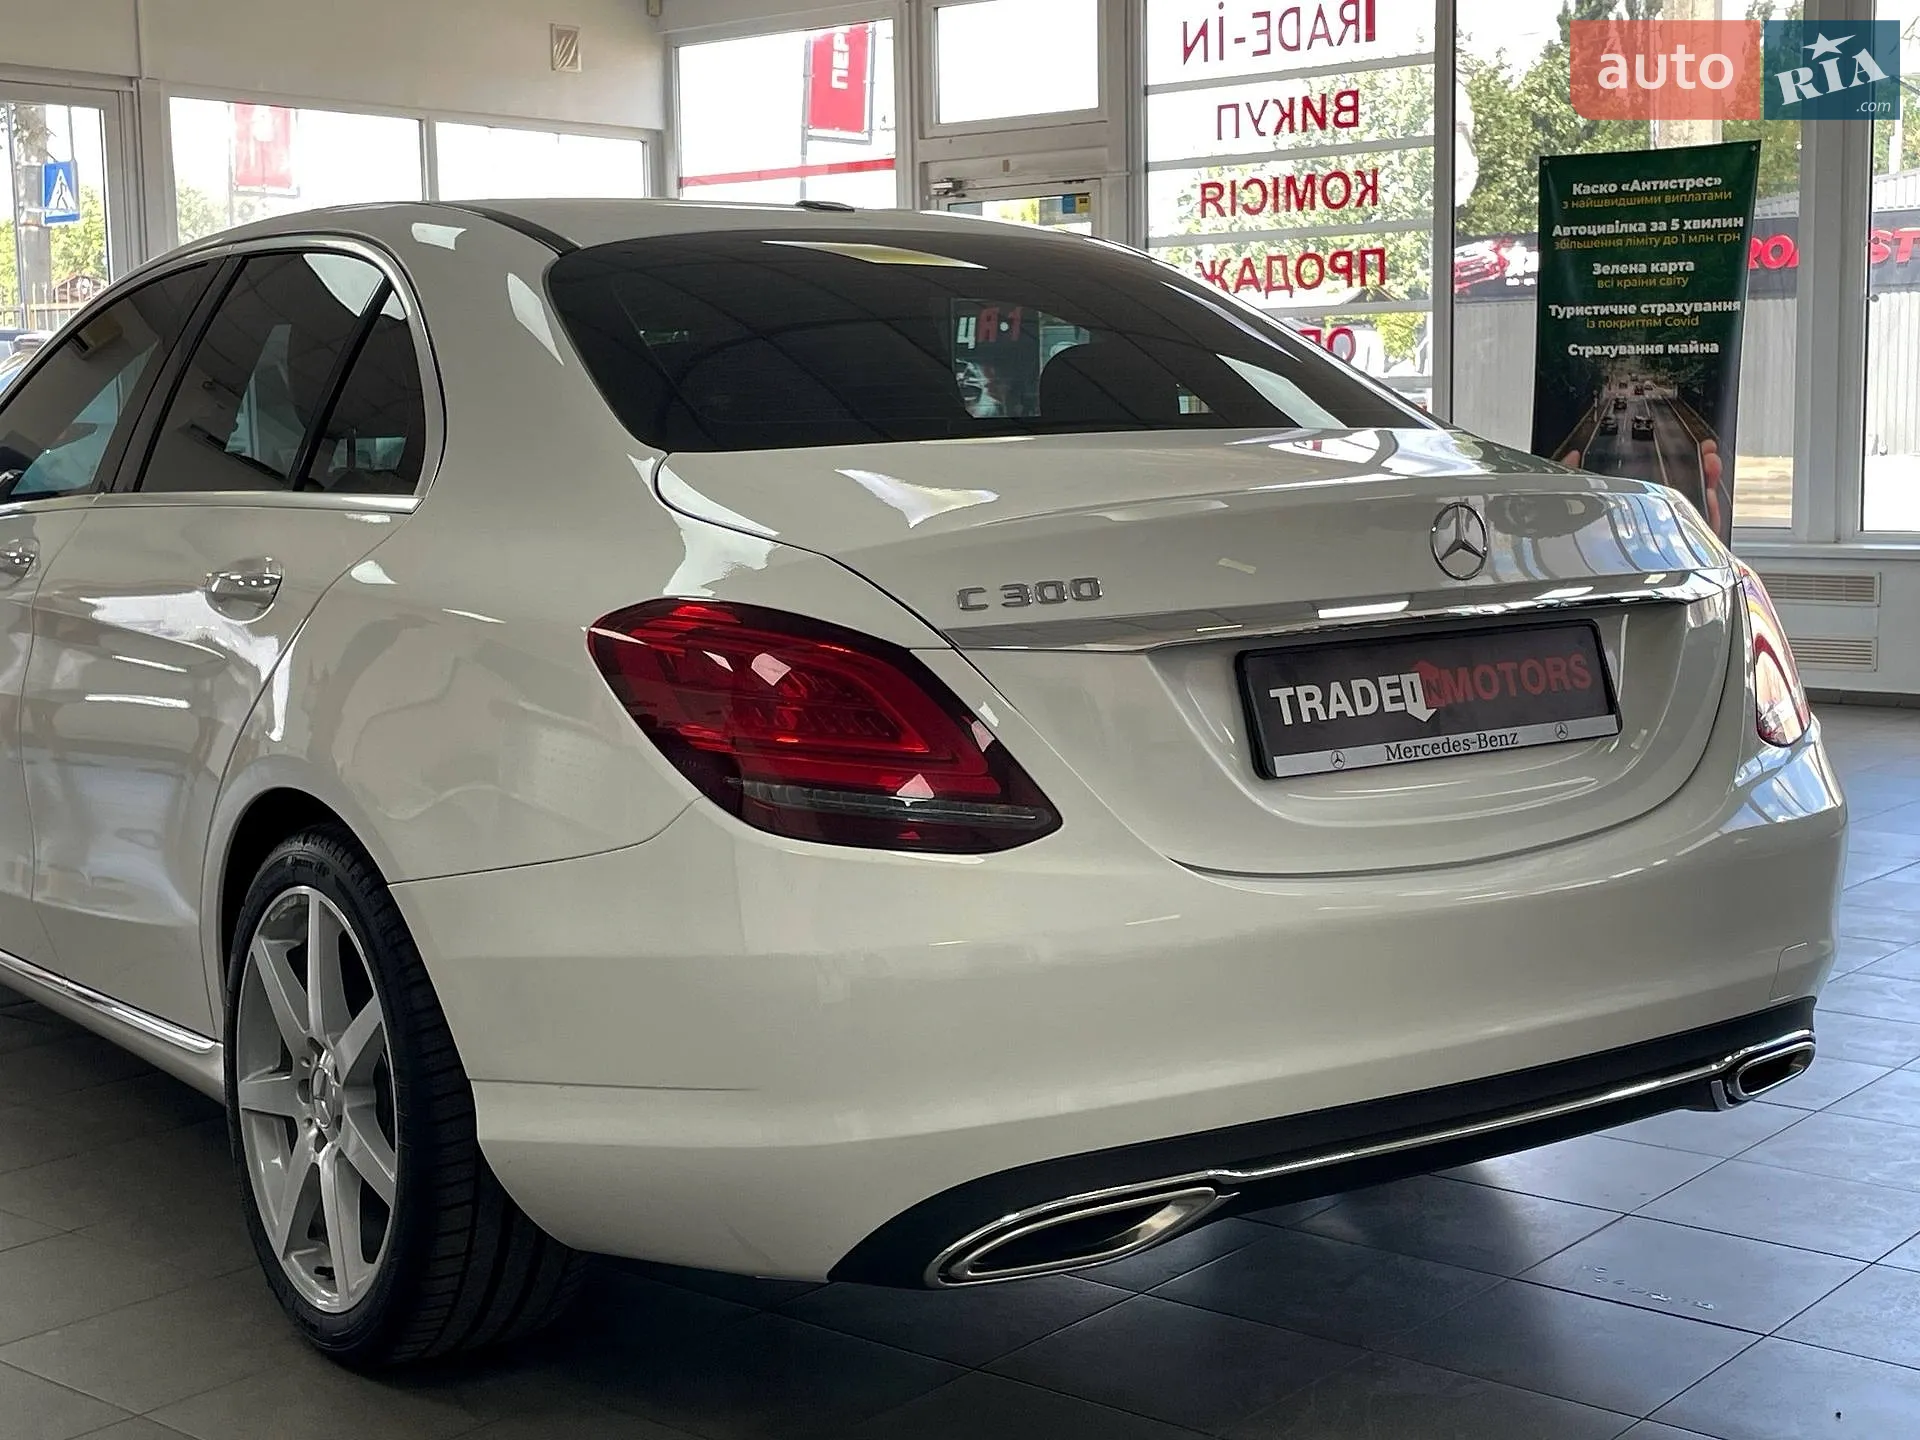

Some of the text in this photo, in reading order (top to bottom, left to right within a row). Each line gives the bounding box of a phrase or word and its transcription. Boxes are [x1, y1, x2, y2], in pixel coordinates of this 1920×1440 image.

[1572, 176, 1722, 195] Каско «Антистрес»
[1571, 194, 1661, 209] найшвидшими
[1664, 191, 1732, 204] виплатами
[1552, 217, 1744, 237] Автоцивілка за 5 хвилин
[1554, 237, 1622, 250] збільшення
[1624, 234, 1661, 248] ліміту
[1663, 235, 1678, 246] до
[1688, 232, 1714, 243] млн
[1717, 231, 1741, 244] грн
[1592, 261, 1695, 275] Зелена карта
[1597, 277, 1614, 289] всі
[1660, 275, 1689, 288] світу
[1548, 301, 1741, 319] Туристичне страхування
[1598, 316, 1662, 330] покриттям
[1664, 315, 1700, 327] Covid
[1567, 340, 1720, 358] Страхування майна
[957, 577, 1104, 611] C 300
[1440, 654, 1593, 704] MOTORS
[1385, 731, 1520, 763] Mercedes-Benz
